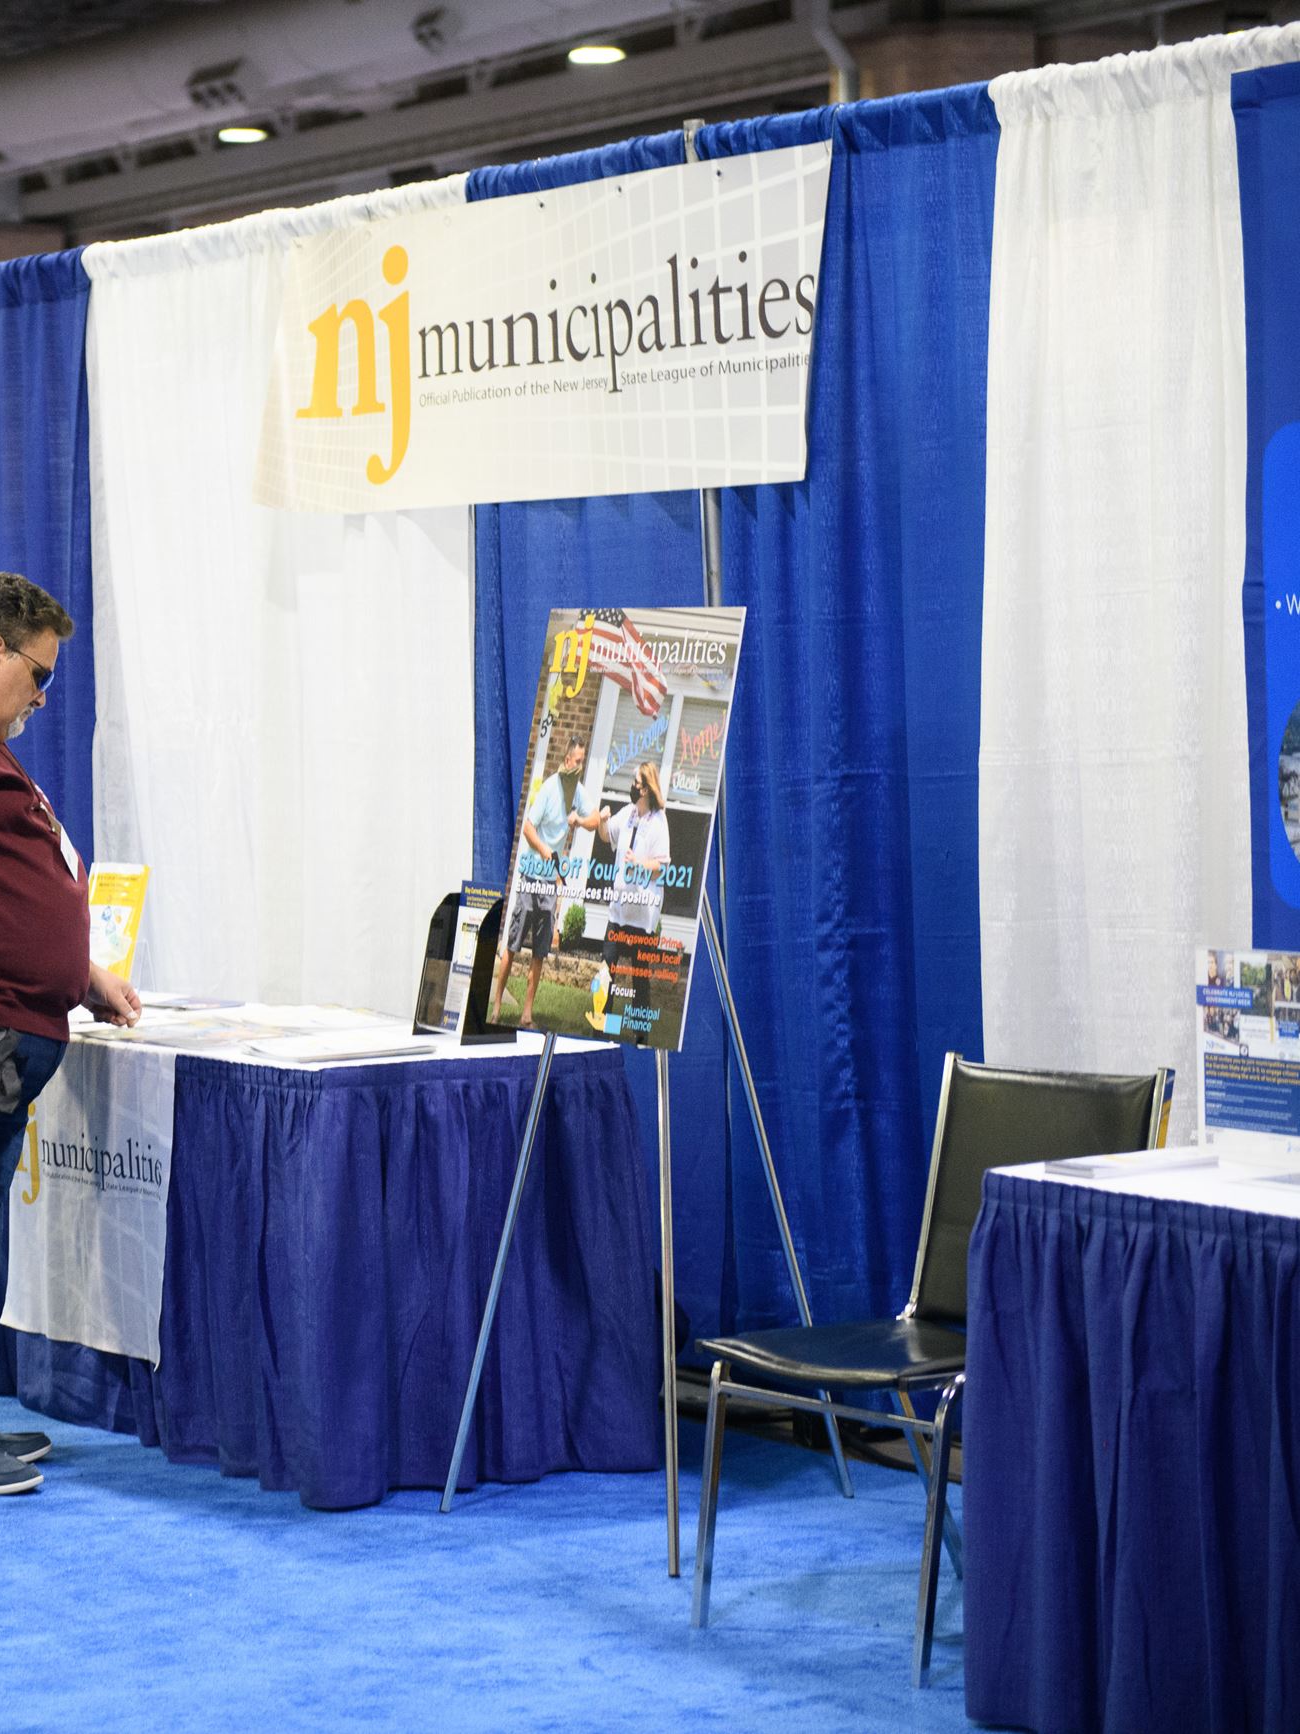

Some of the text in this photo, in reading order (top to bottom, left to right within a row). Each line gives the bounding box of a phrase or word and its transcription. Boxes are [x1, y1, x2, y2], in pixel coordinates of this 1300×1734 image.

[296, 245, 816, 487] nj municipalities
[419, 351, 811, 408] Official Publication of the New Jersey State League of Municipalitie
[549, 613, 727, 698] nj municipalities
[518, 852, 693, 890] Show Off Your City 2021
[516, 880, 661, 907] Evesham embraces the positive
[608, 929, 660, 947] Collingswood
[637, 949, 682, 965] keeps local
[610, 984, 636, 998] Focus:
[624, 1004, 661, 1021] Municipal
[622, 1016, 652, 1032] Finance
